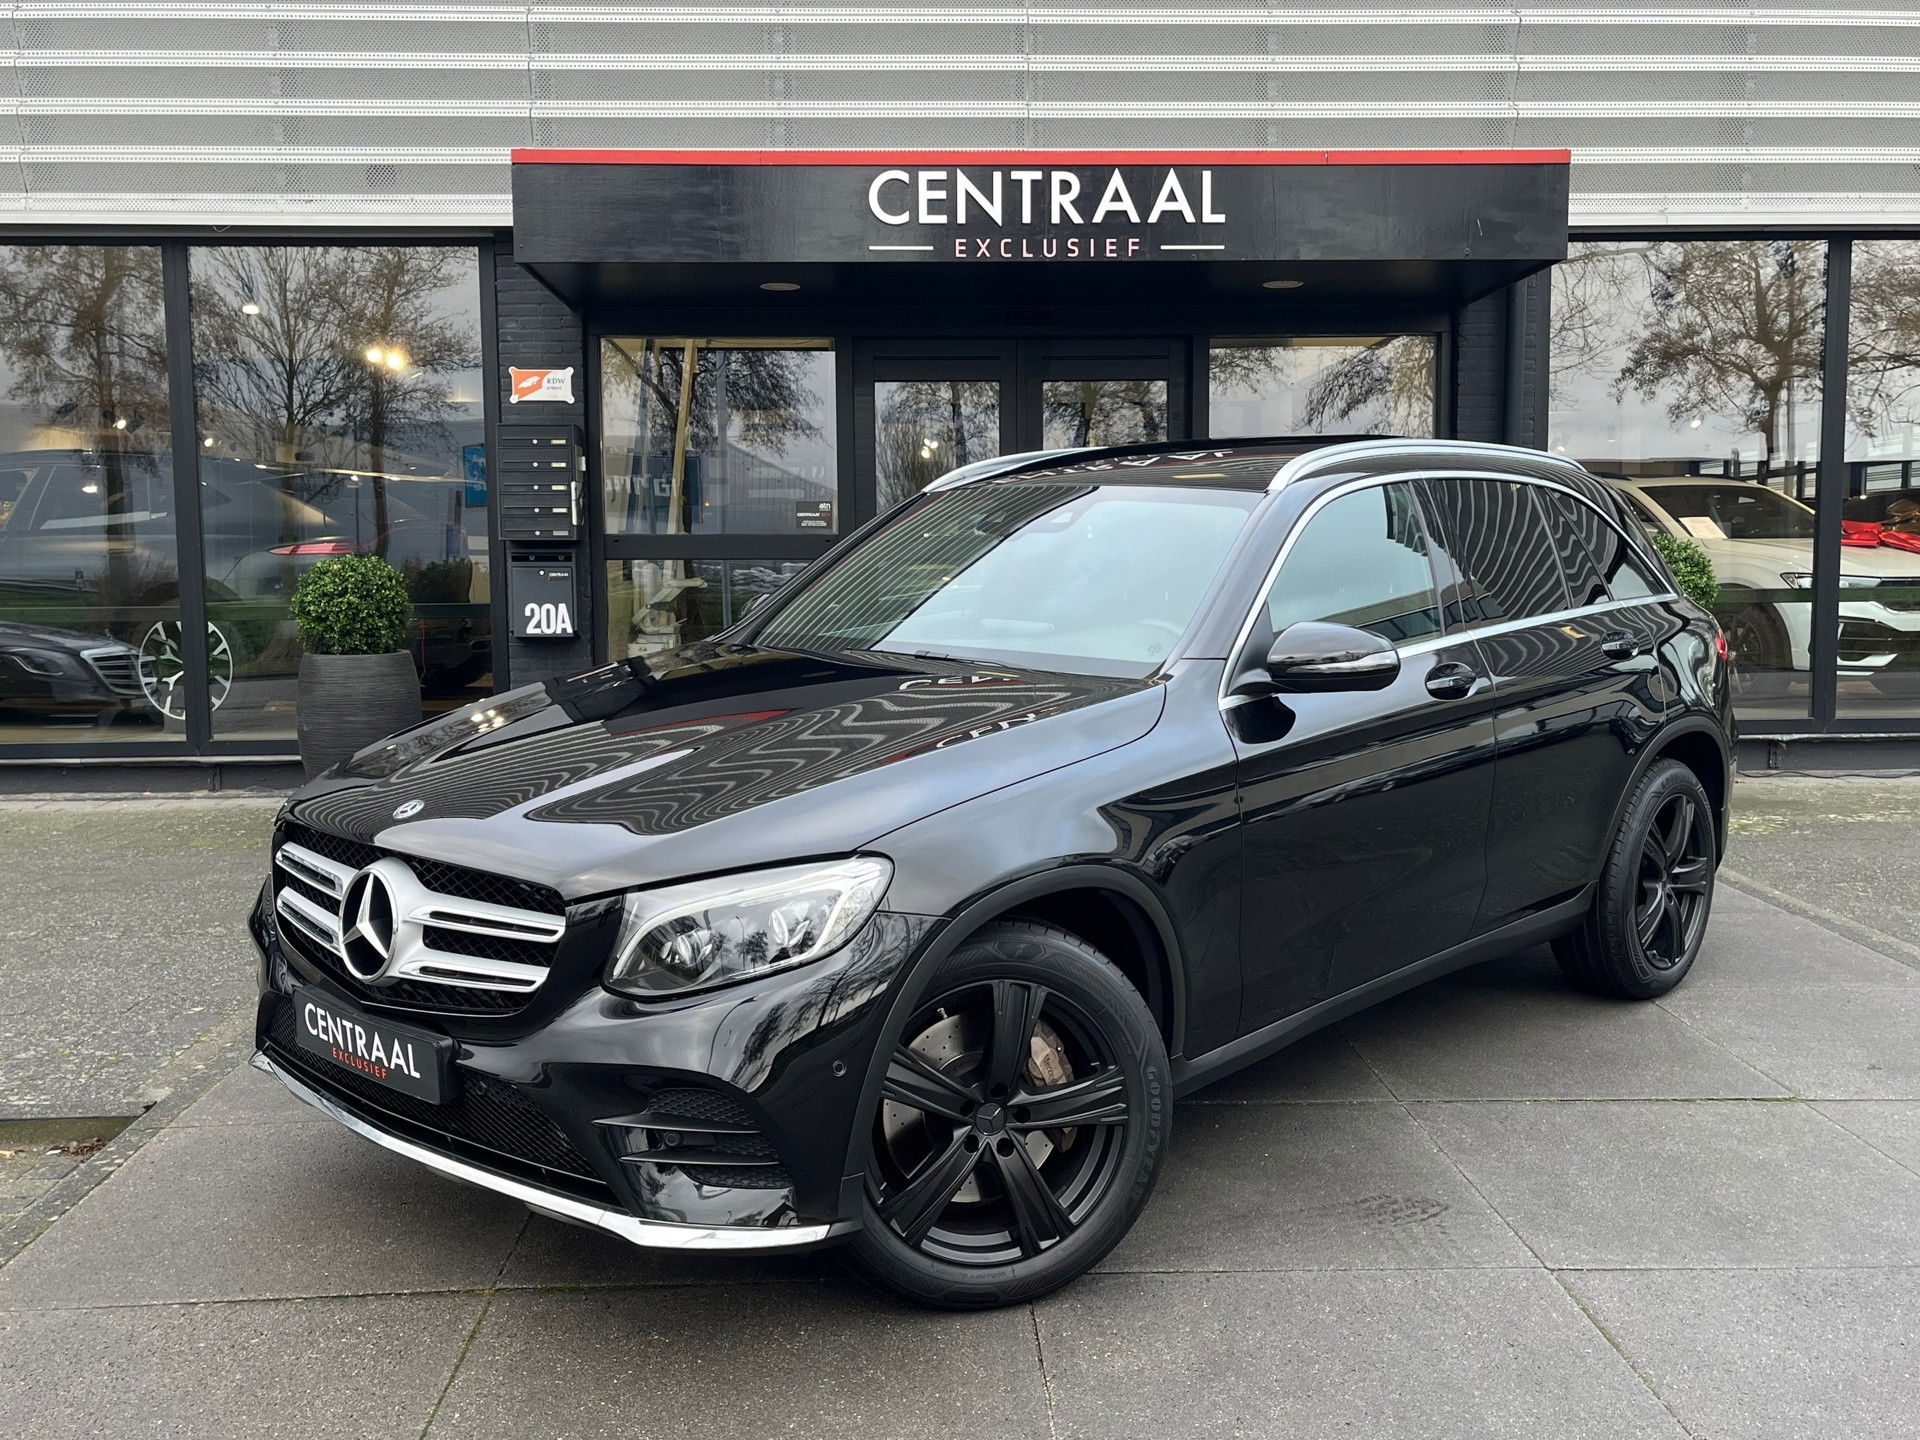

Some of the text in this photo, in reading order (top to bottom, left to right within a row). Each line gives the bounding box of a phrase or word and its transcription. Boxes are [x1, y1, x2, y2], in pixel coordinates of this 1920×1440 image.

[868, 167, 1226, 226] CENTRAAL
[955, 238, 1140, 258] EXCLUSIEF
[546, 377, 566, 385] RDW
[524, 603, 573, 635] 20A
[304, 1002, 421, 1079] CENTRAAL
[332, 1047, 388, 1079] EXCLUSIEF
